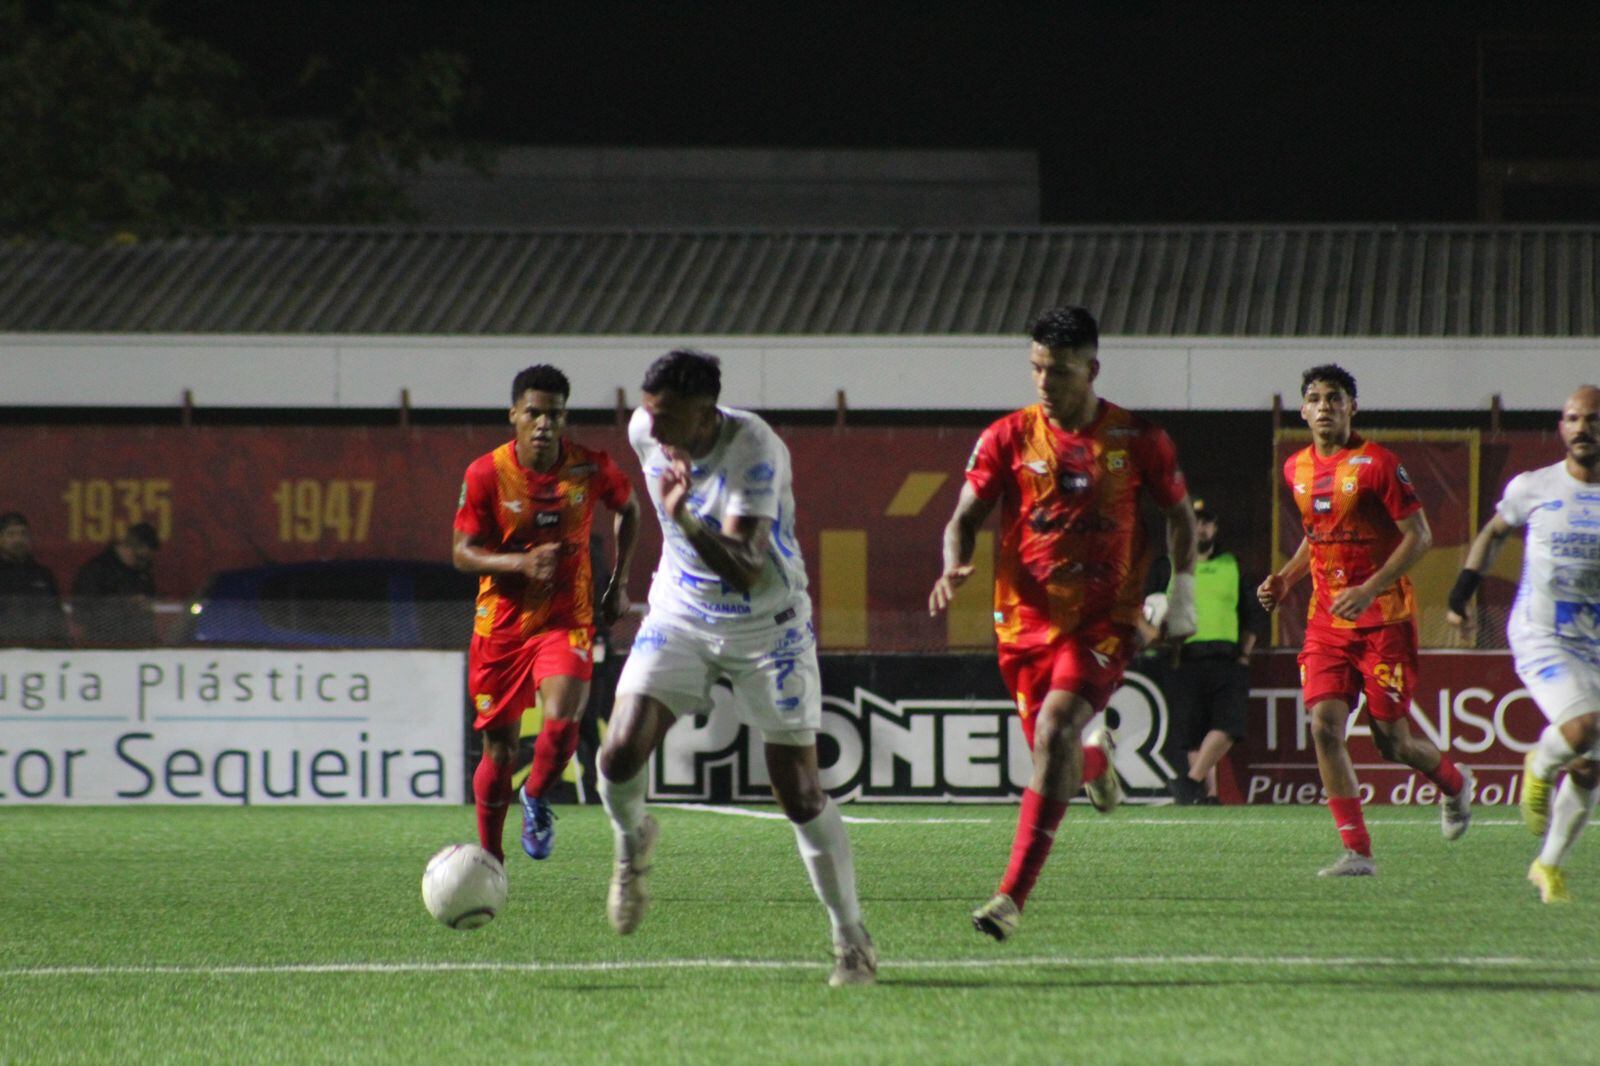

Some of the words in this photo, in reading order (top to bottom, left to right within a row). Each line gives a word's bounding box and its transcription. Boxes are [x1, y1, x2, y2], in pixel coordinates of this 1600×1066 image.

[63, 478, 173, 543] 1935
[274, 479, 376, 543] 1947
[139, 661, 371, 722] Plástica
[0, 748, 87, 798] or
[115, 732, 446, 805] Sequeira
[1246, 775, 1376, 804] Pueso
